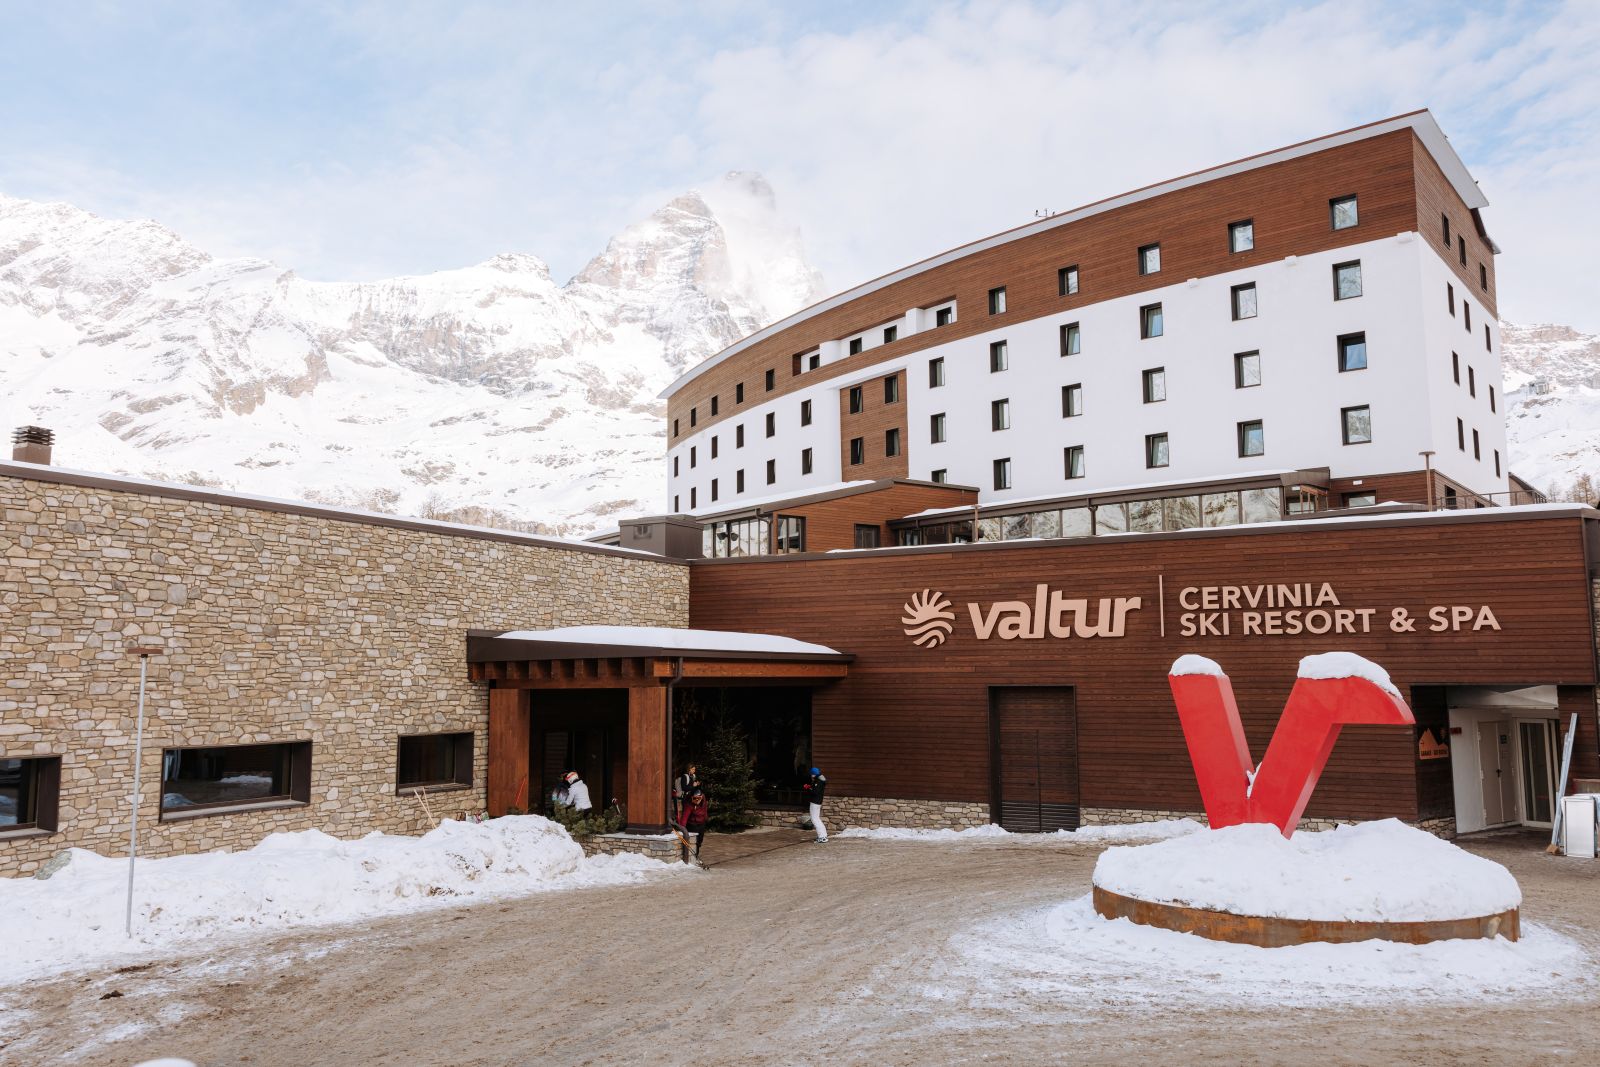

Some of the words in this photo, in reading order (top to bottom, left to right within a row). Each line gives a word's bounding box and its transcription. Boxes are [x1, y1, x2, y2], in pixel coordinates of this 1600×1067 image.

[967, 583, 1142, 640] valtur
[1179, 582, 1341, 610] CERVINIA
[1180, 612, 1230, 637] SKI
[1242, 608, 1376, 635] RESORT
[1389, 607, 1417, 633] &
[1428, 605, 1502, 632] SPA
